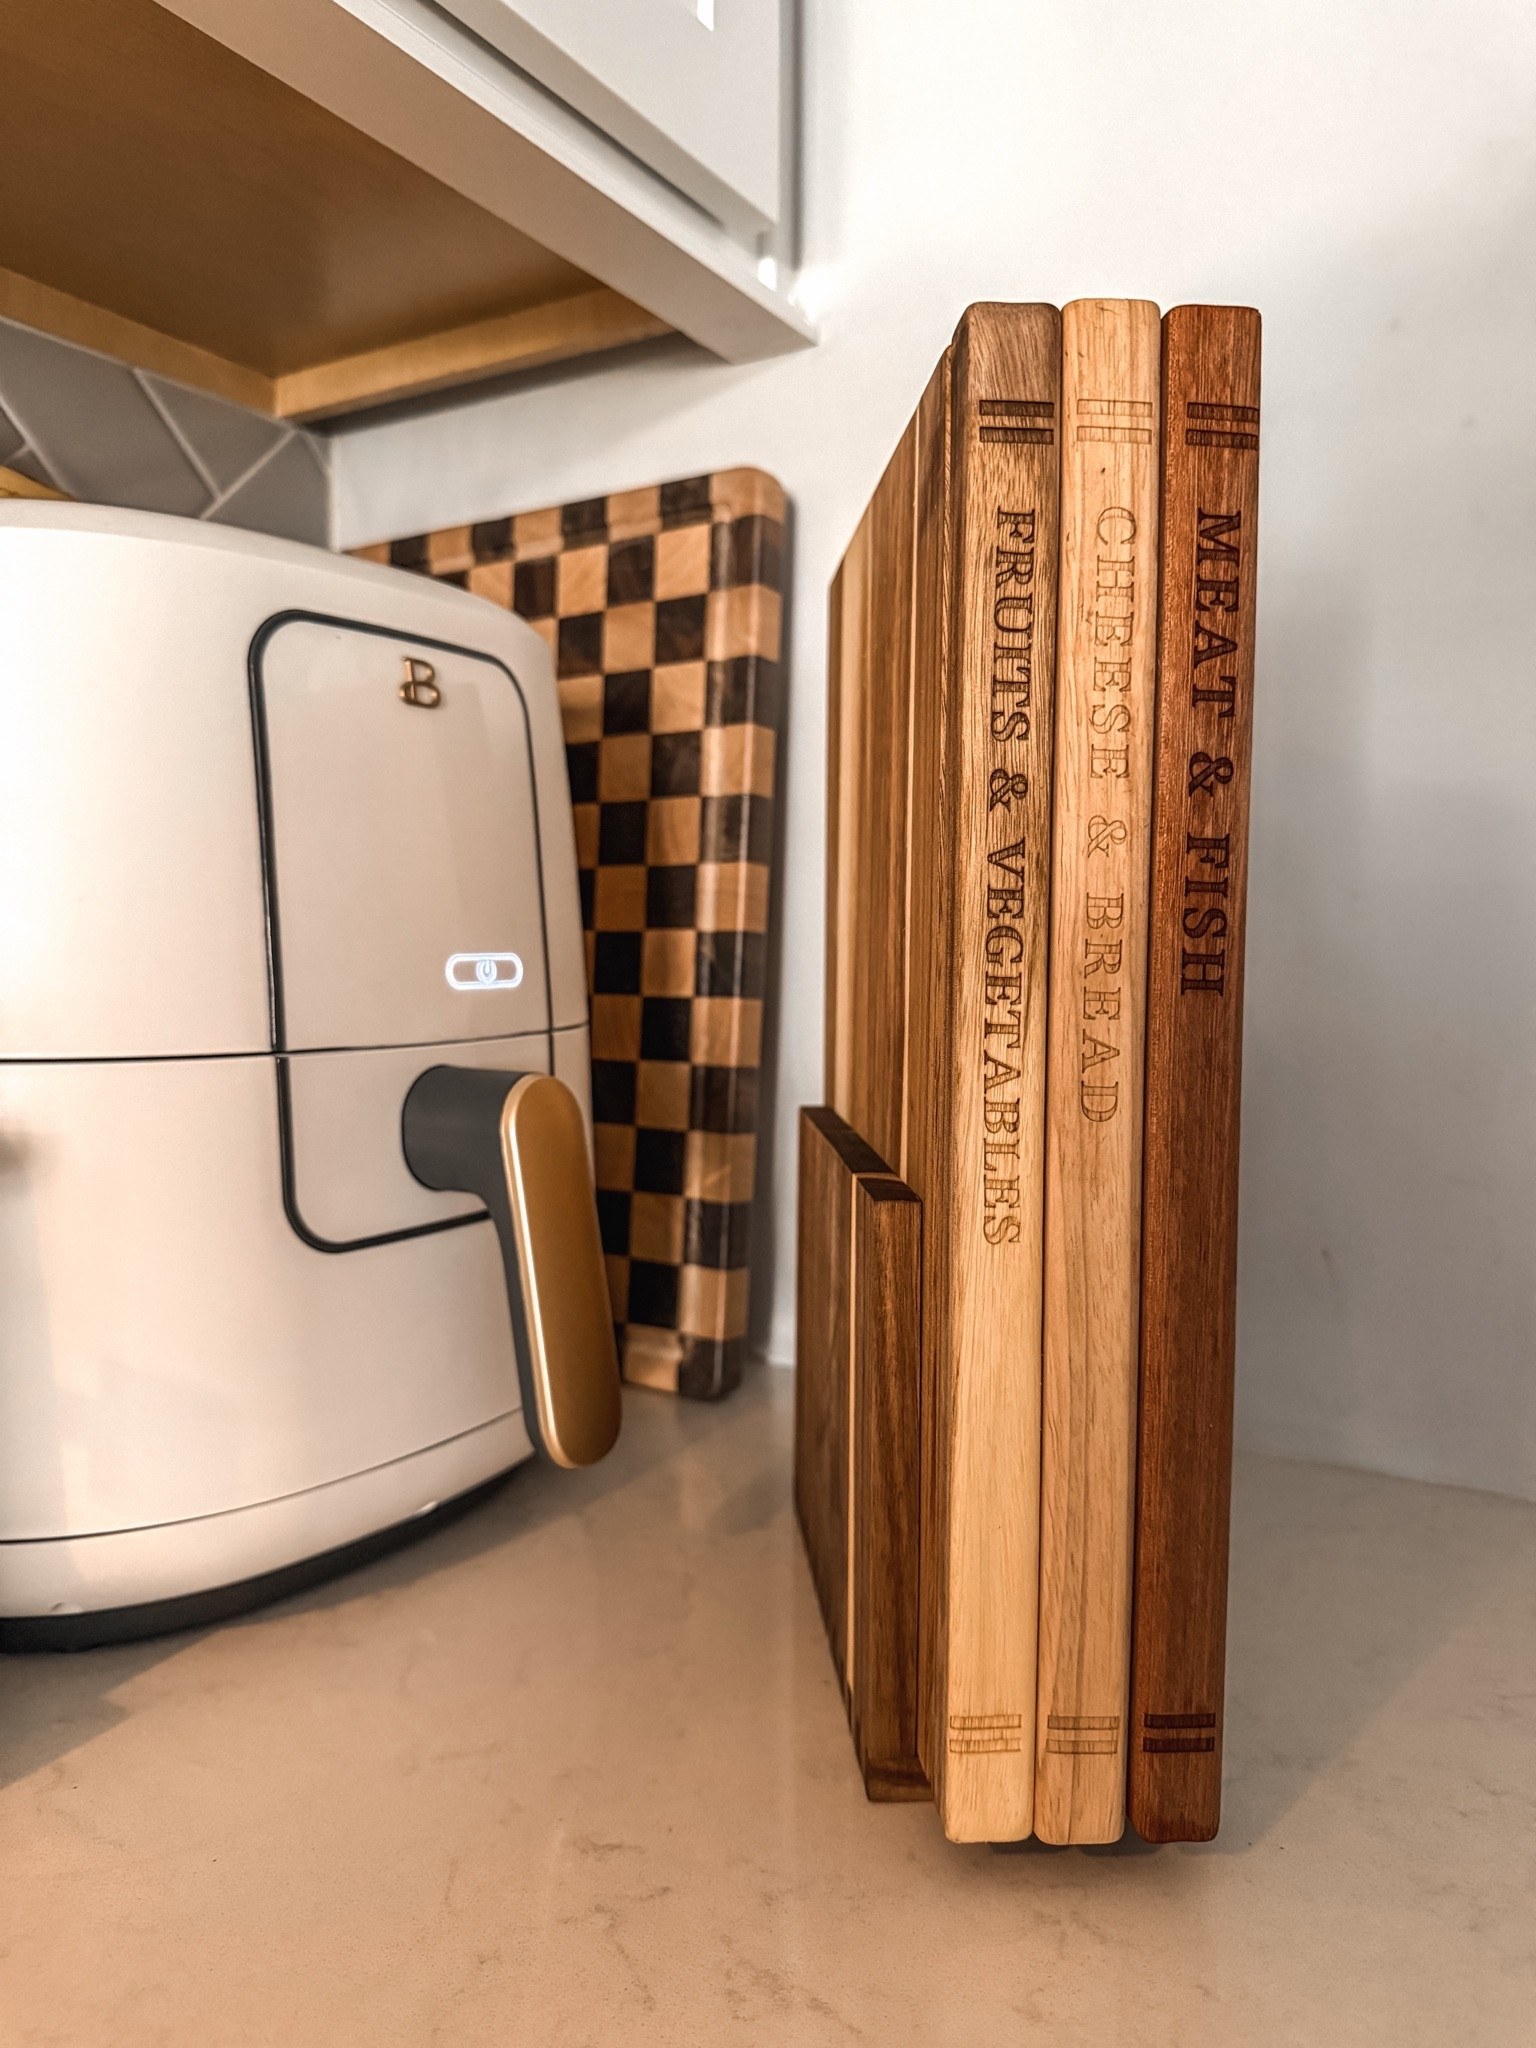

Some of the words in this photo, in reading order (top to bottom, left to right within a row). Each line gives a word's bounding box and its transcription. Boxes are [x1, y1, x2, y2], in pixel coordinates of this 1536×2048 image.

[399, 656, 442, 710] B
[990, 506, 1036, 743] FRUITS
[1088, 506, 1137, 779] CHEESE
[1192, 507, 1242, 718] MEAT
[989, 768, 1029, 813] &
[1087, 815, 1127, 858] &
[1188, 751, 1234, 798] &
[1081, 892, 1124, 1123] BREAD
[1181, 832, 1231, 997] FISH
[983, 836, 1026, 1246] VEGETABLES
